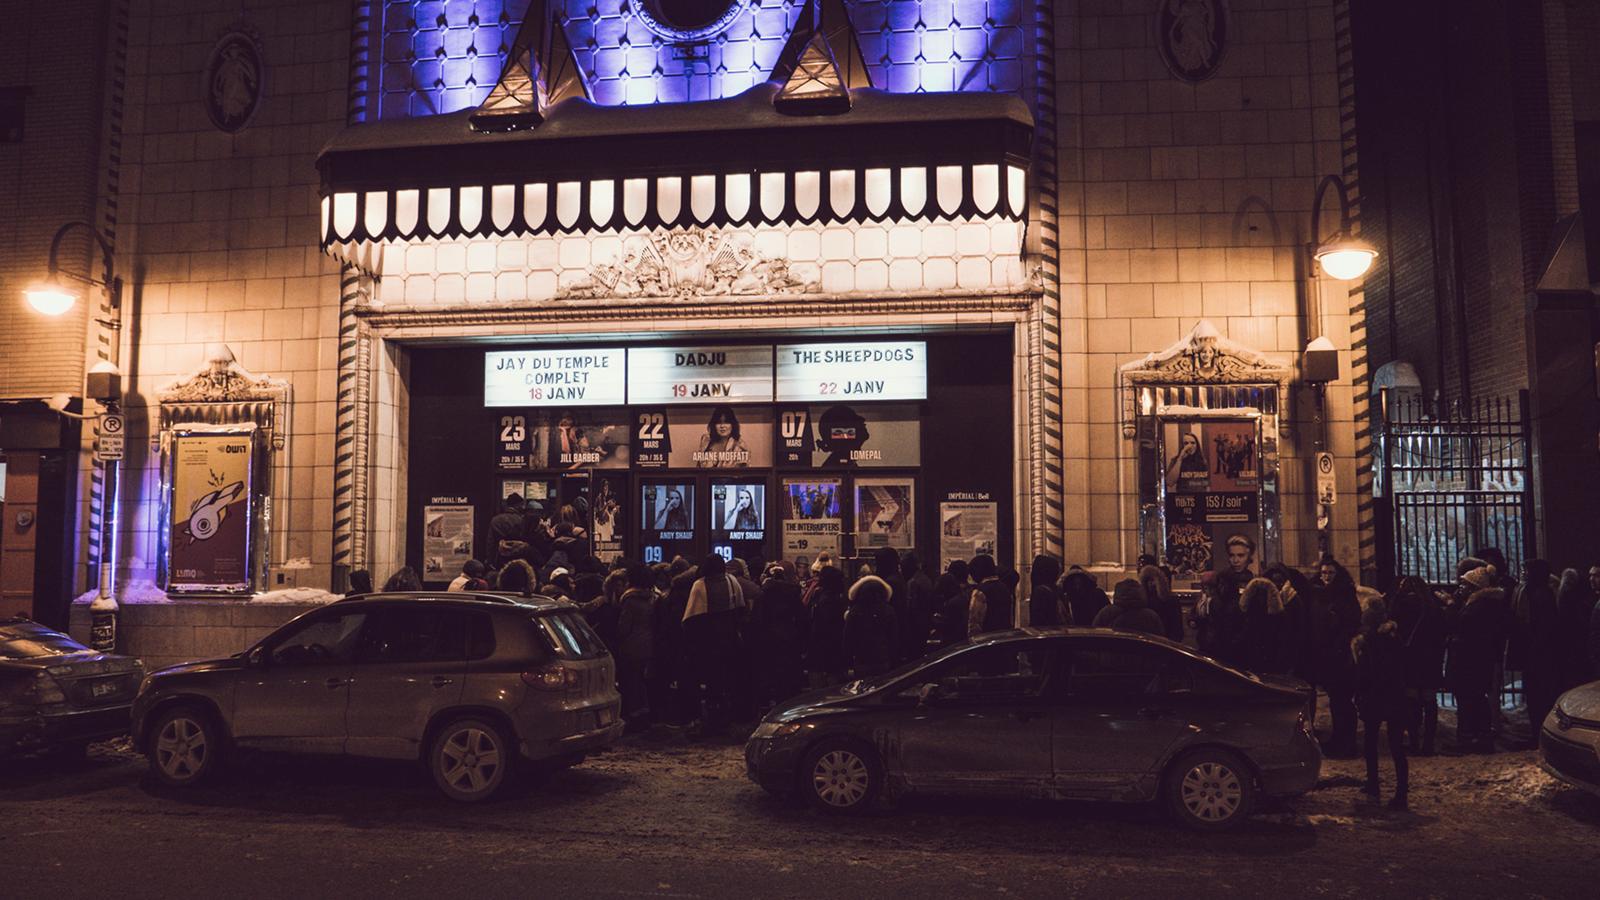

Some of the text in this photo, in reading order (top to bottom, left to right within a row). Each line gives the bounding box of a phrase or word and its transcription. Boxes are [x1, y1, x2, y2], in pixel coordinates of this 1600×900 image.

[675, 352, 726, 366] DADJU
[793, 348, 914, 364] THE SHEEPDOGS
[497, 356, 609, 370] JAY DU TEMPLE
[525, 371, 589, 385] COMPLET
[529, 387, 585, 399] 18 JANV
[672, 383, 731, 397] 19 JANV
[820, 381, 884, 394] 22 JANV
[501, 416, 526, 441] 23
[639, 413, 664, 439] 22
[782, 411, 807, 438] 07
[643, 440, 659, 448] MARS
[786, 439, 802, 447] MARS
[560, 453, 600, 463] JILL BARBER
[693, 452, 749, 461] ARIANE MOFFATT
[850, 450, 881, 460] LOMEPAL
[786, 523, 840, 531] THE INTERRUPTERS
[660, 531, 674, 539] ANDY
[729, 531, 764, 540] ANDY SHAUF
[797, 539, 808, 549] 19
[645, 546, 662, 563] 09
